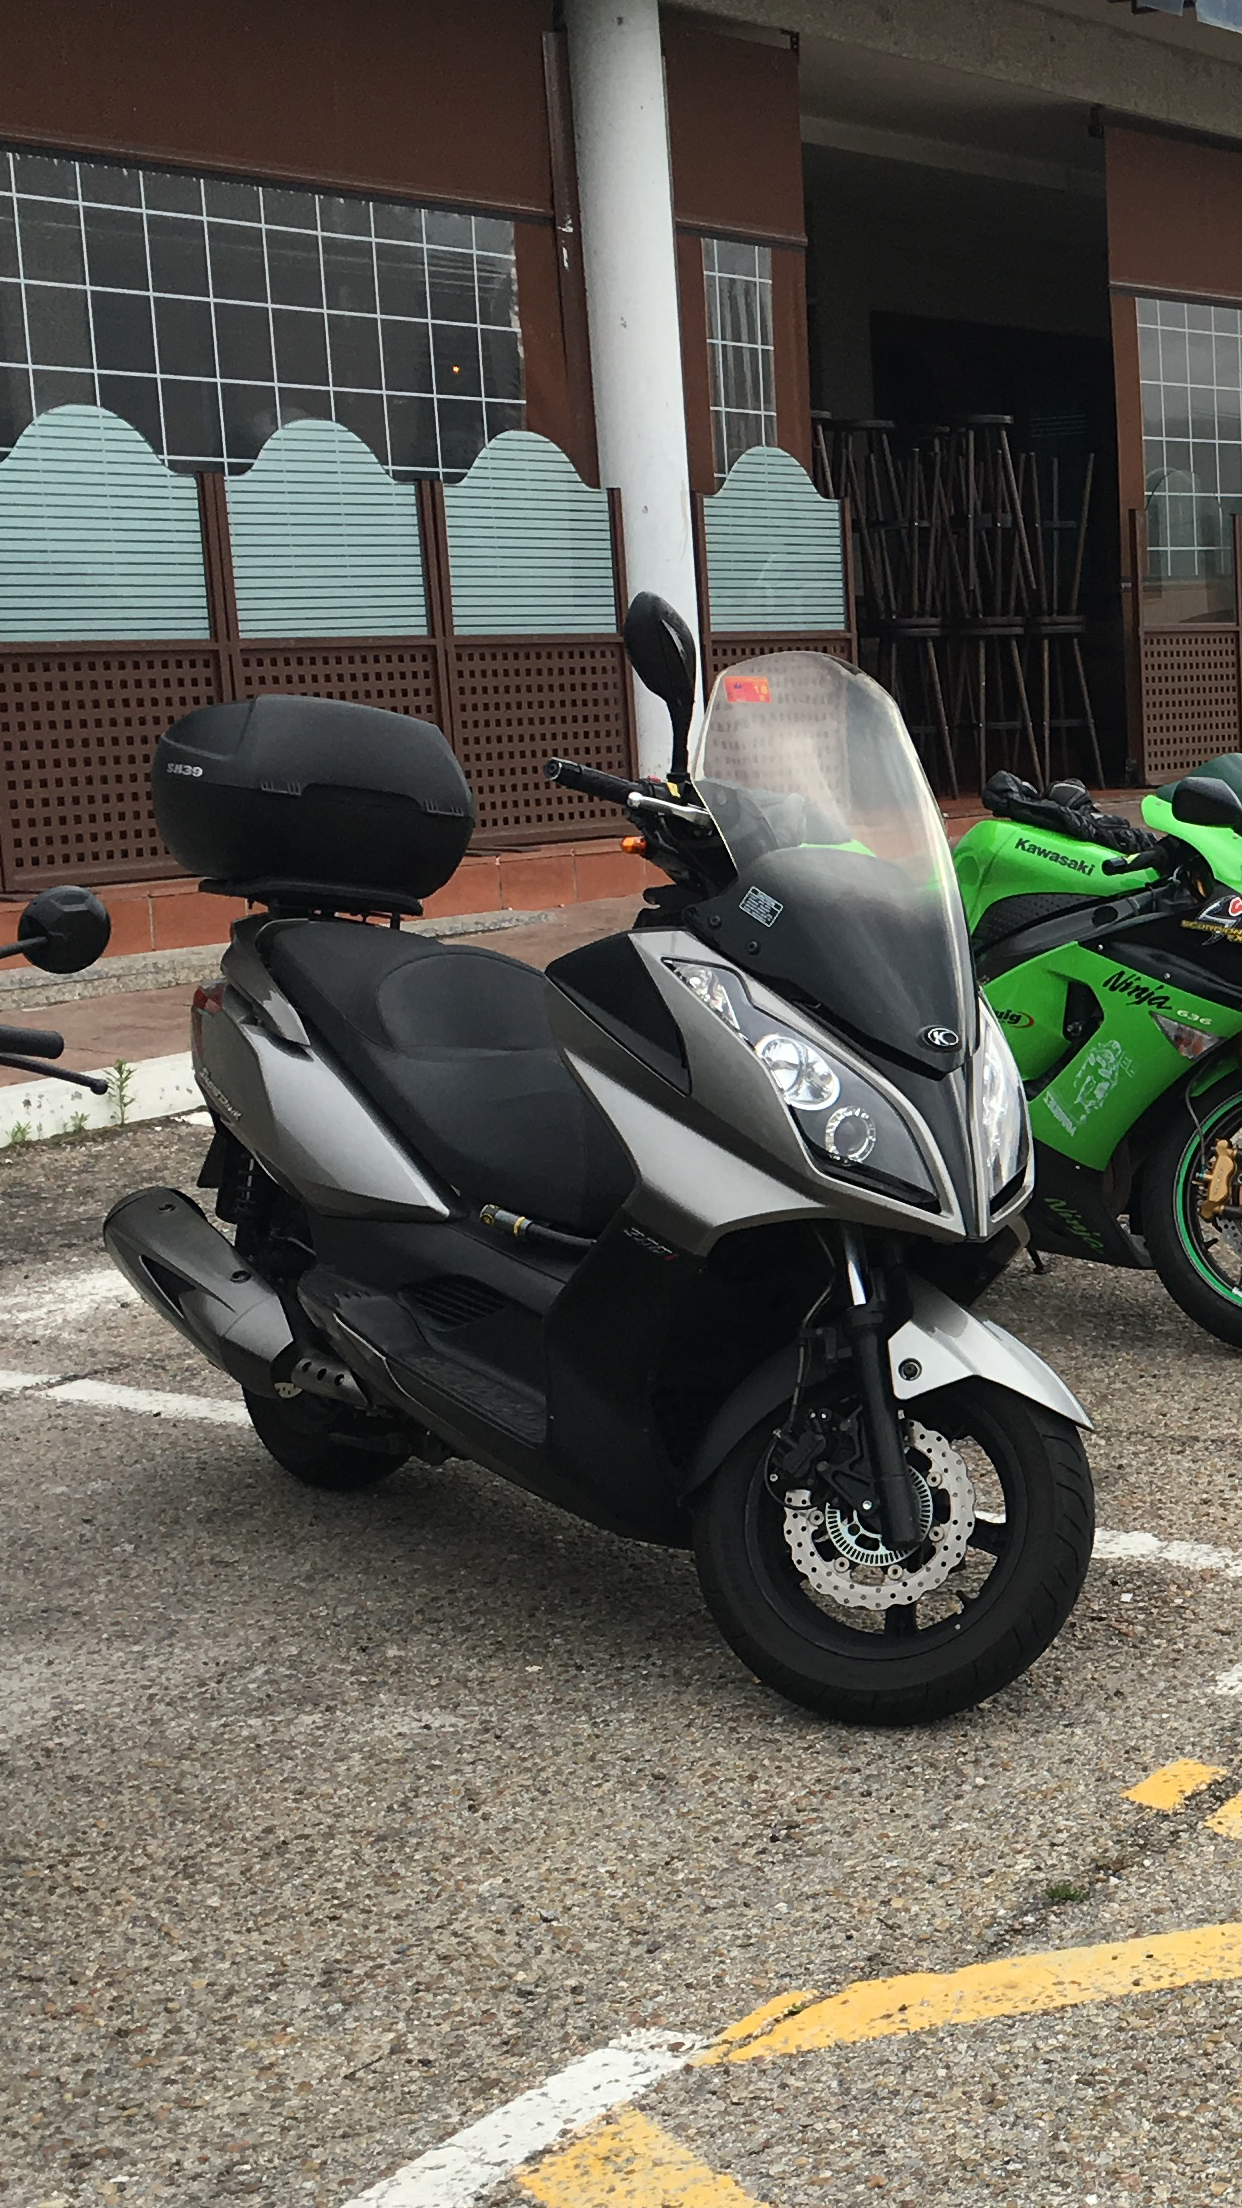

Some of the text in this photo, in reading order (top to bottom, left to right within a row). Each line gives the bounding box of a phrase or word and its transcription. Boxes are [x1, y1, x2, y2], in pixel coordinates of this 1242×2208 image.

[166, 762, 203, 777] SH39
[1014, 837, 1096, 876] Kawasaki
[994, 1009, 1022, 1025] uig
[1101, 970, 1212, 1025] Ninja 636
[1043, 1197, 1105, 1255] Ninja
